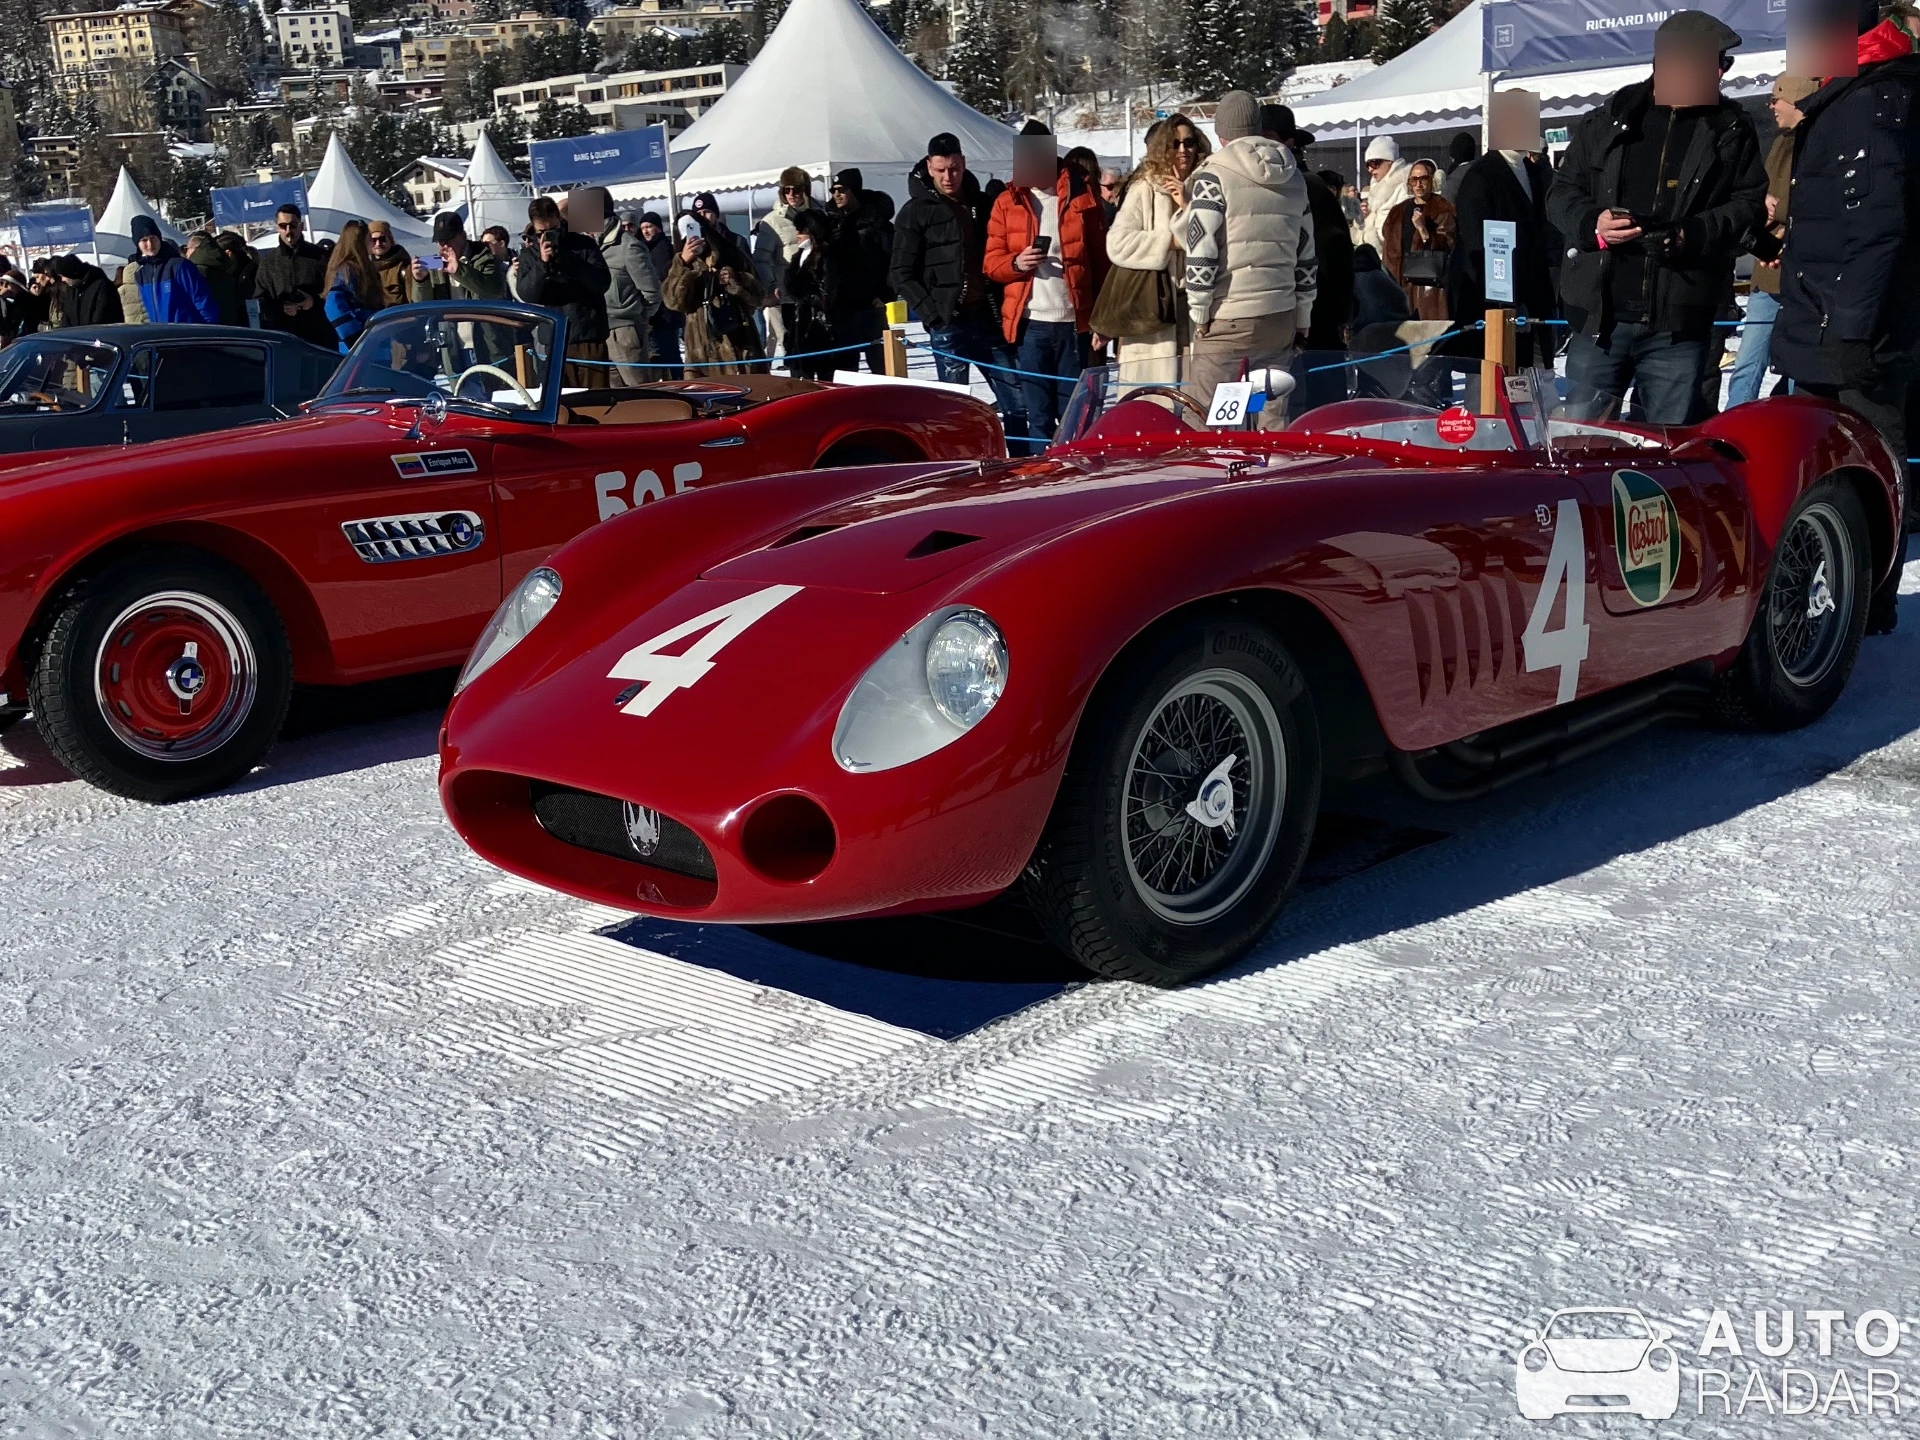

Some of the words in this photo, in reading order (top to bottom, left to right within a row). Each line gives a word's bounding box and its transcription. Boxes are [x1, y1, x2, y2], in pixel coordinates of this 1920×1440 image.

[1586, 14, 1644, 31] RICHARD
[1215, 400, 1239, 421] 68
[428, 458, 452, 468] Enrique
[1628, 500, 1668, 566] Castrol
[1521, 498, 1590, 706] 4
[606, 584, 806, 717] 4
